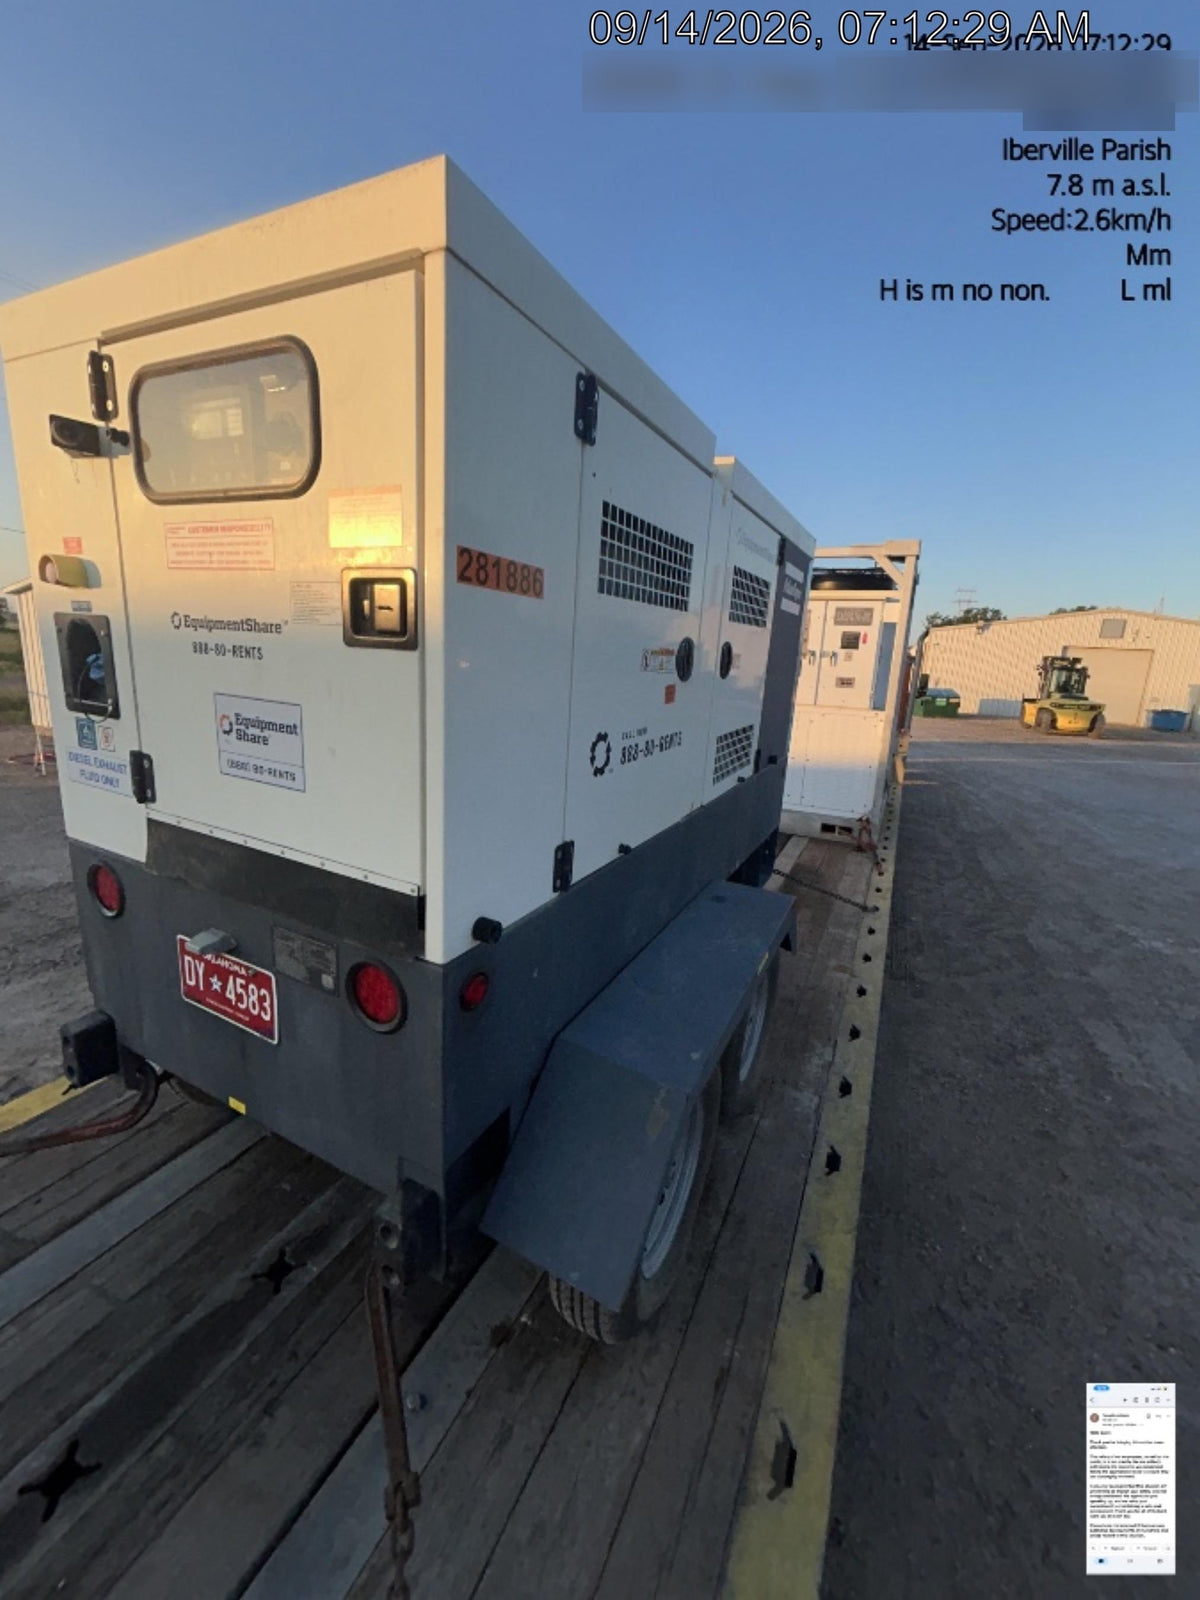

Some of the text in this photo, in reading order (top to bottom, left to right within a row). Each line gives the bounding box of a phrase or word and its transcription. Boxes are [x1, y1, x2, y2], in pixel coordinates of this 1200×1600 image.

[458, 547, 544, 599] 281886
[184, 614, 283, 634] EquipmentShare
[234, 712, 299, 736] Equipment
[235, 728, 270, 746] Share
[184, 955, 205, 991] DY
[225, 972, 271, 1021] 4583
